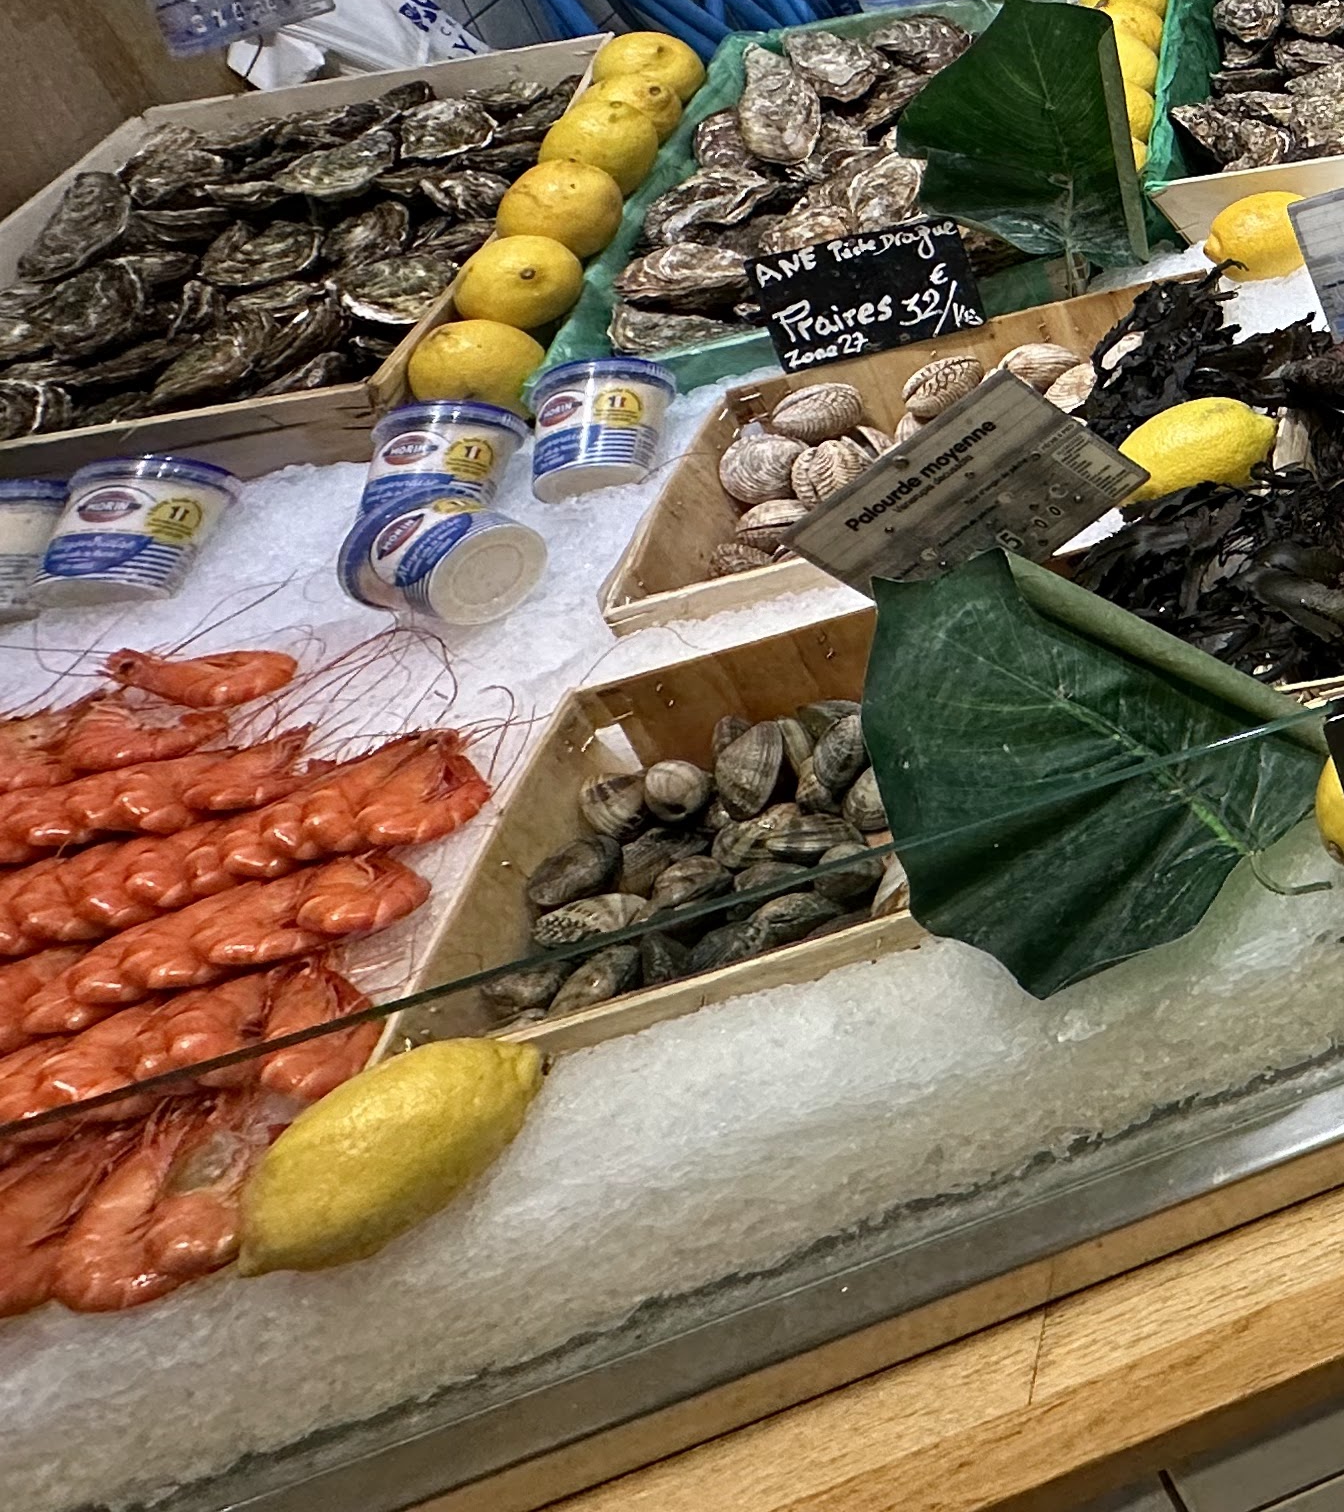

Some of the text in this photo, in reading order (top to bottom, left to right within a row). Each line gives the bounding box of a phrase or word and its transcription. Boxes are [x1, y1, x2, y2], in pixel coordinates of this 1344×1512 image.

[773, 295, 893, 343] Praires
[840, 334, 869, 354] 27
[845, 419, 997, 532] Palourde moyenne
[382, 519, 415, 551] MORIN
